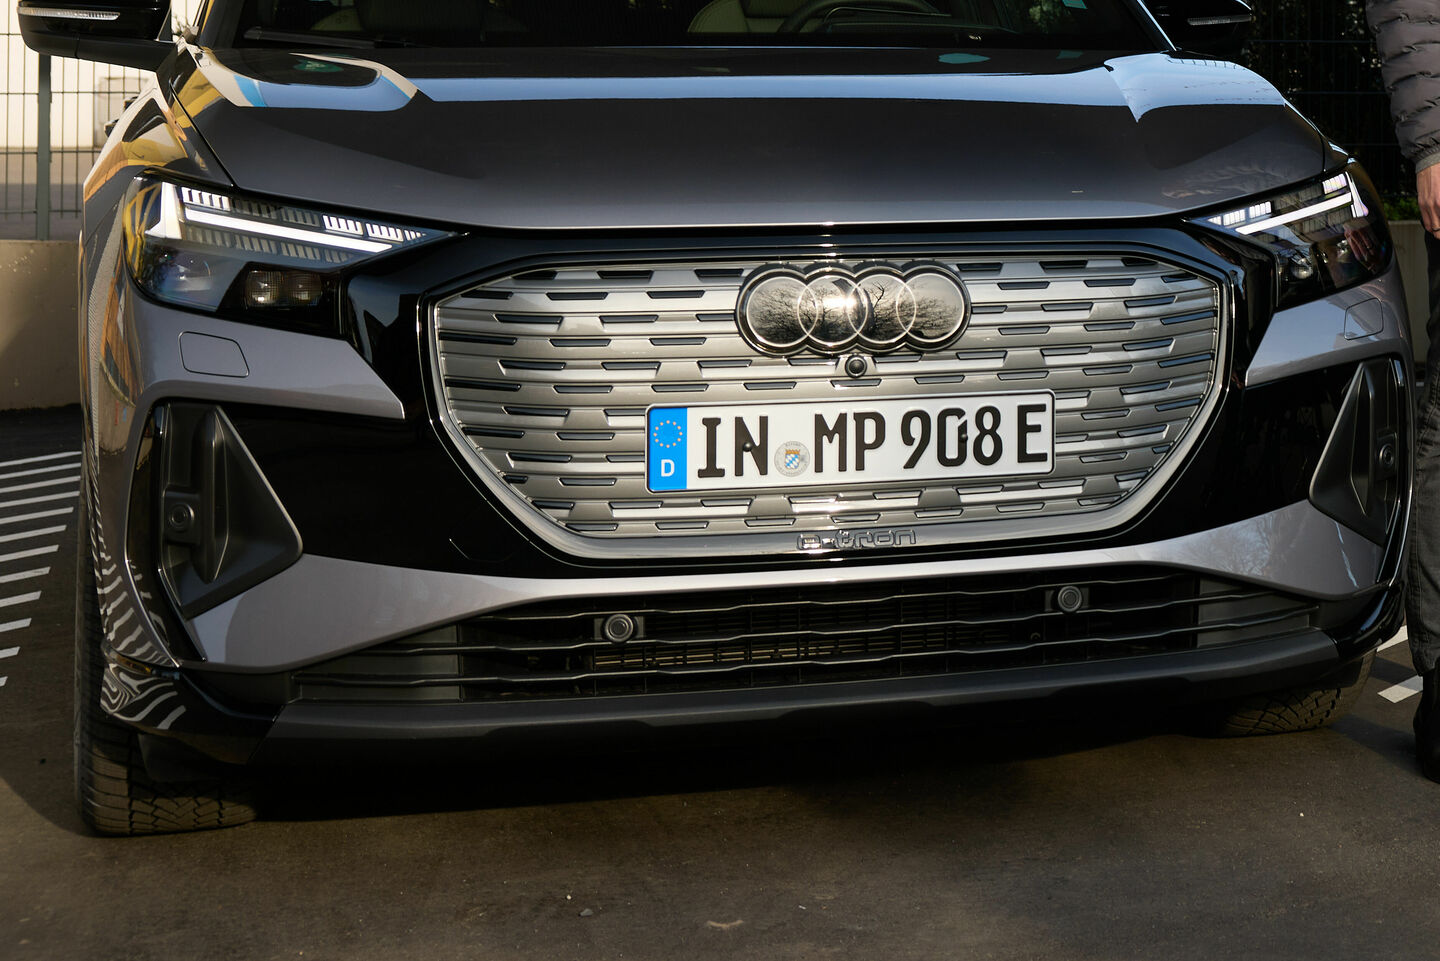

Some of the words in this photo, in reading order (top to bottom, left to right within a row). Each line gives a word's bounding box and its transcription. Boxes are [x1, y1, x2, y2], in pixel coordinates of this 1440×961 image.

[697, 415, 768, 478] IN
[814, 411, 886, 473] MP
[660, 458, 675, 477] D
[796, 529, 917, 551] e-tron
